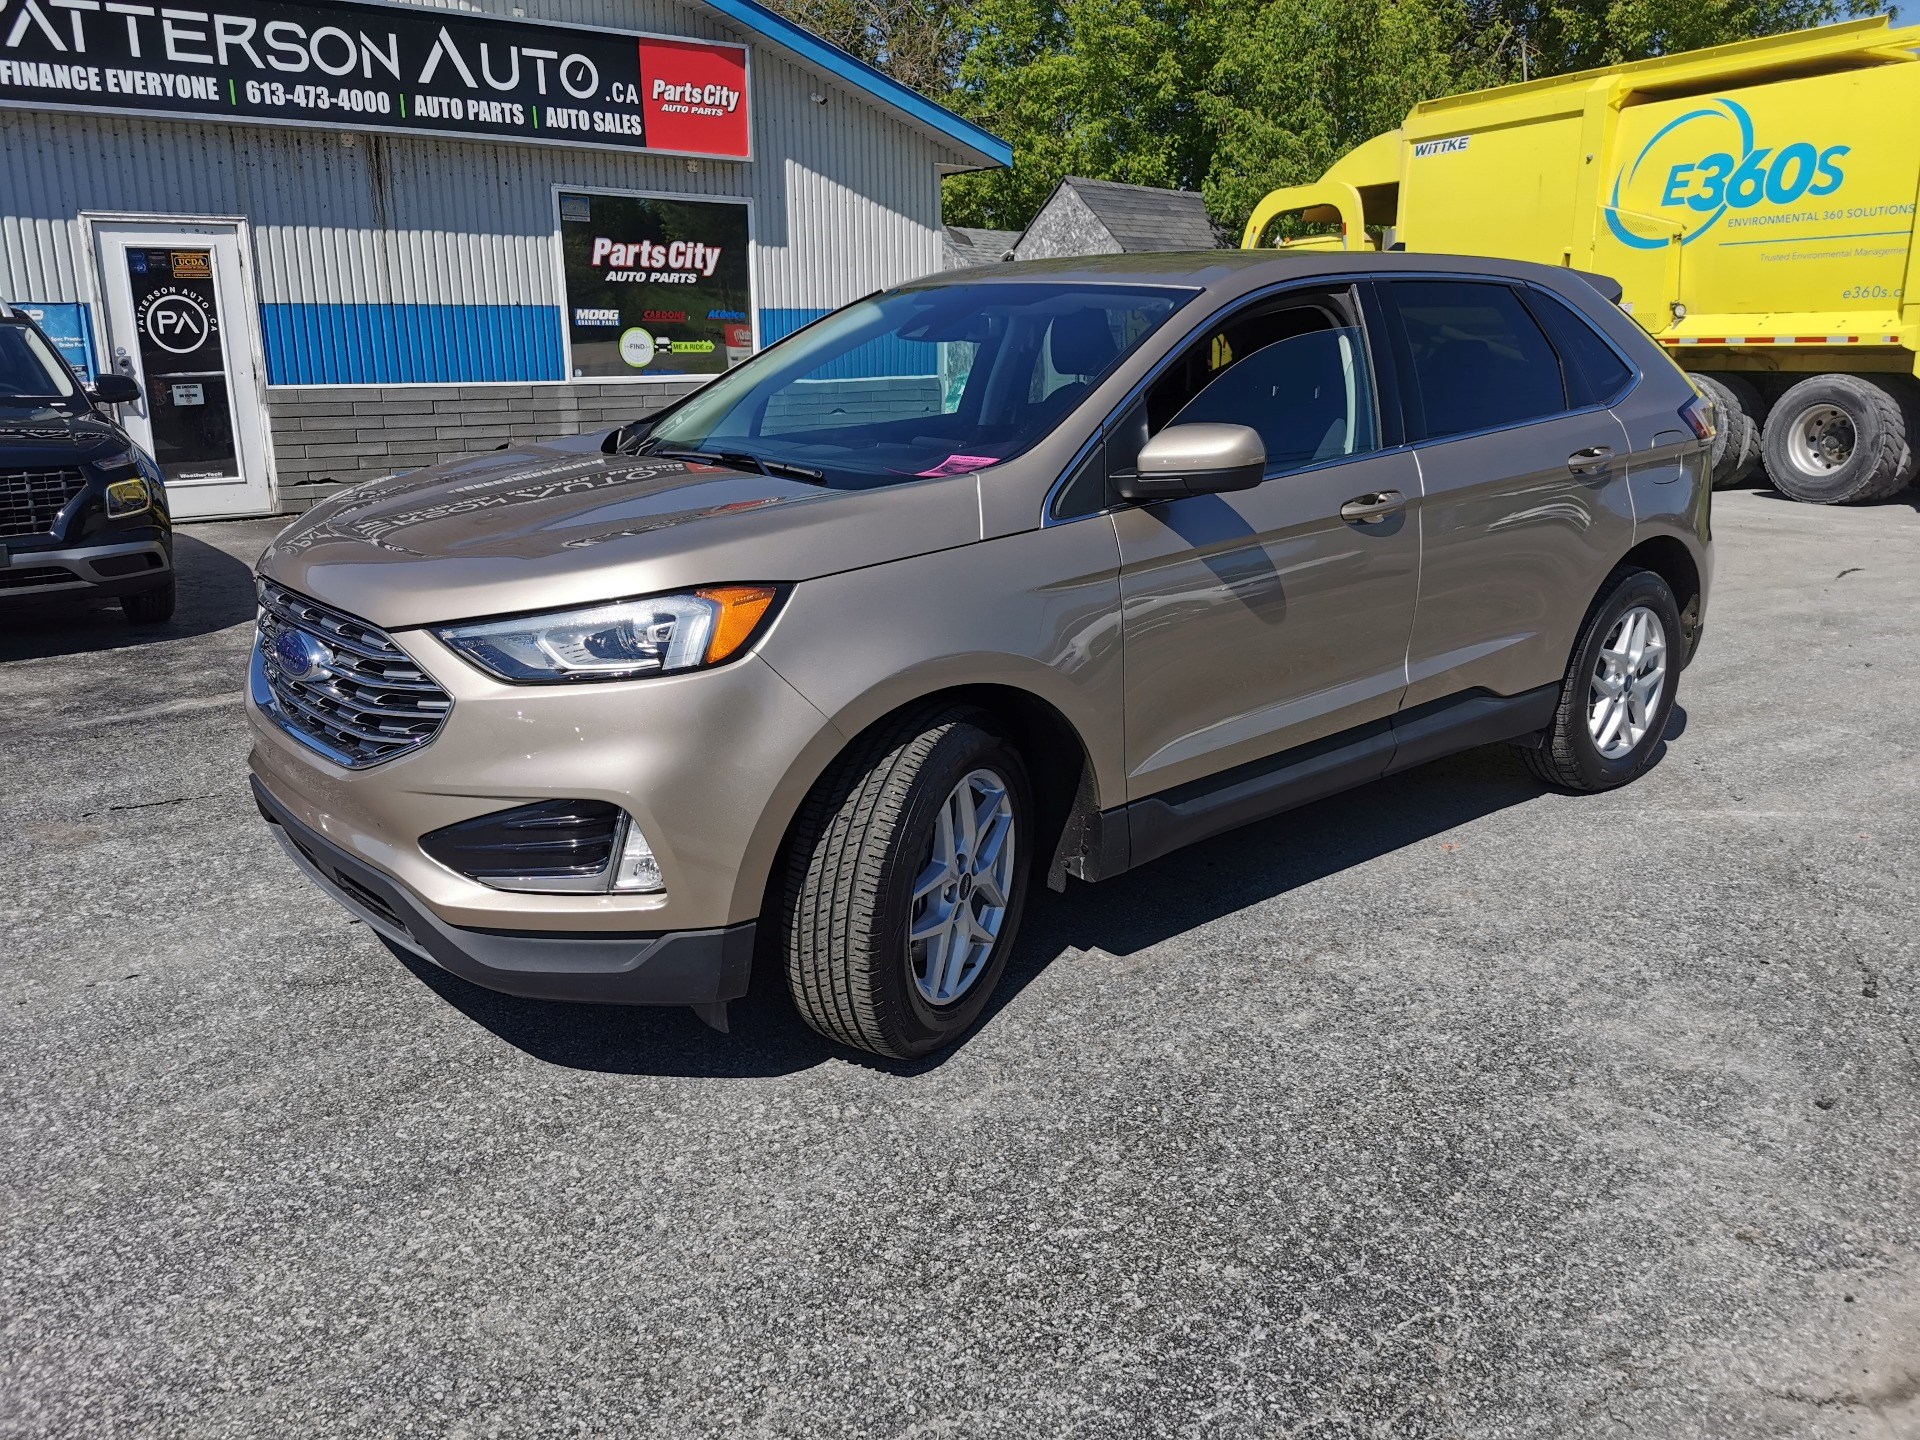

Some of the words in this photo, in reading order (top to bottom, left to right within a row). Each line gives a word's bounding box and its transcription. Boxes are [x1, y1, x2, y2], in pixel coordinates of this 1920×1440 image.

[0, 0, 401, 81] ATTERSON
[417, 25, 599, 99] AUTO
[605, 82, 640, 105] .CA
[0, 59, 102, 91] FINANCE
[104, 68, 220, 101] EVERYONE
[245, 80, 392, 114] 613-473-4000
[415, 95, 463, 120] AUTO
[467, 99, 525, 126] PARTS
[546, 106, 590, 131] AUTO
[593, 112, 642, 136] SALES
[661, 103, 688, 115] AUTO
[691, 105, 724, 117] PARTS
[1660, 142, 1852, 212] E360S
[1728, 211, 1819, 228] ENVIRONMENTAL
[1822, 209, 1843, 220] 360
[1846, 203, 1917, 219] SOLUTIONS
[178, 258, 205, 266] UCDA
[1760, 252, 1790, 262] Trusted
[1791, 249, 1852, 261] Environmental
[605, 271, 647, 283] AUTO
[649, 271, 698, 284] PARTS
[137, 286, 176, 333] PATTERSON
[182, 288, 209, 309] AUTO
[576, 309, 619, 320] MOOG
[642, 310, 686, 319] CARDONE
[156, 310, 201, 335] PA
